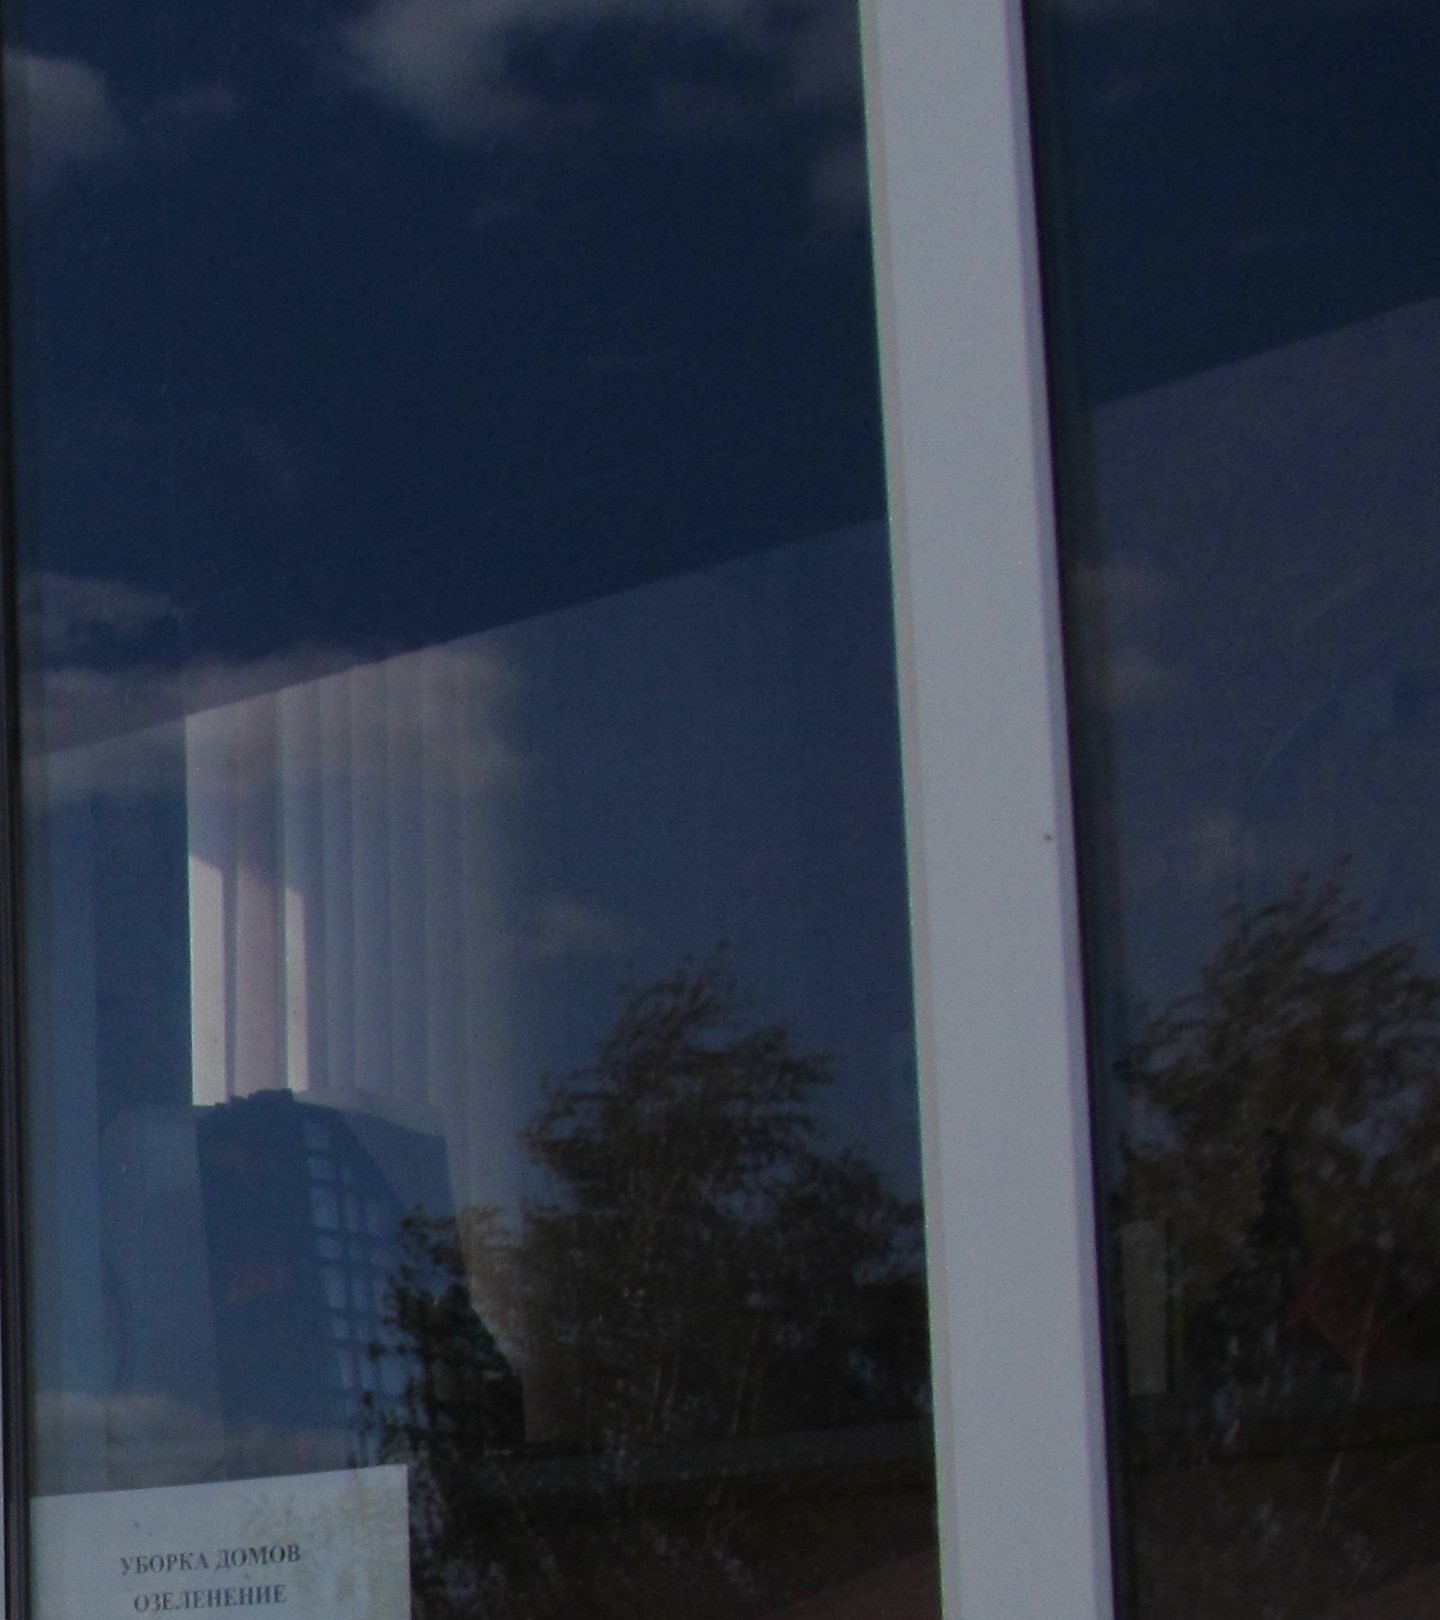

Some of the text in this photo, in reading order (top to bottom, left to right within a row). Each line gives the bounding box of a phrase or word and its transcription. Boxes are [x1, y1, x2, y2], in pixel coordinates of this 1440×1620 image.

[119, 1543, 302, 1576] УБОРКА ДОМОВ
[133, 1583, 287, 1613] ОЗЕЛЕНЕНИЕ
